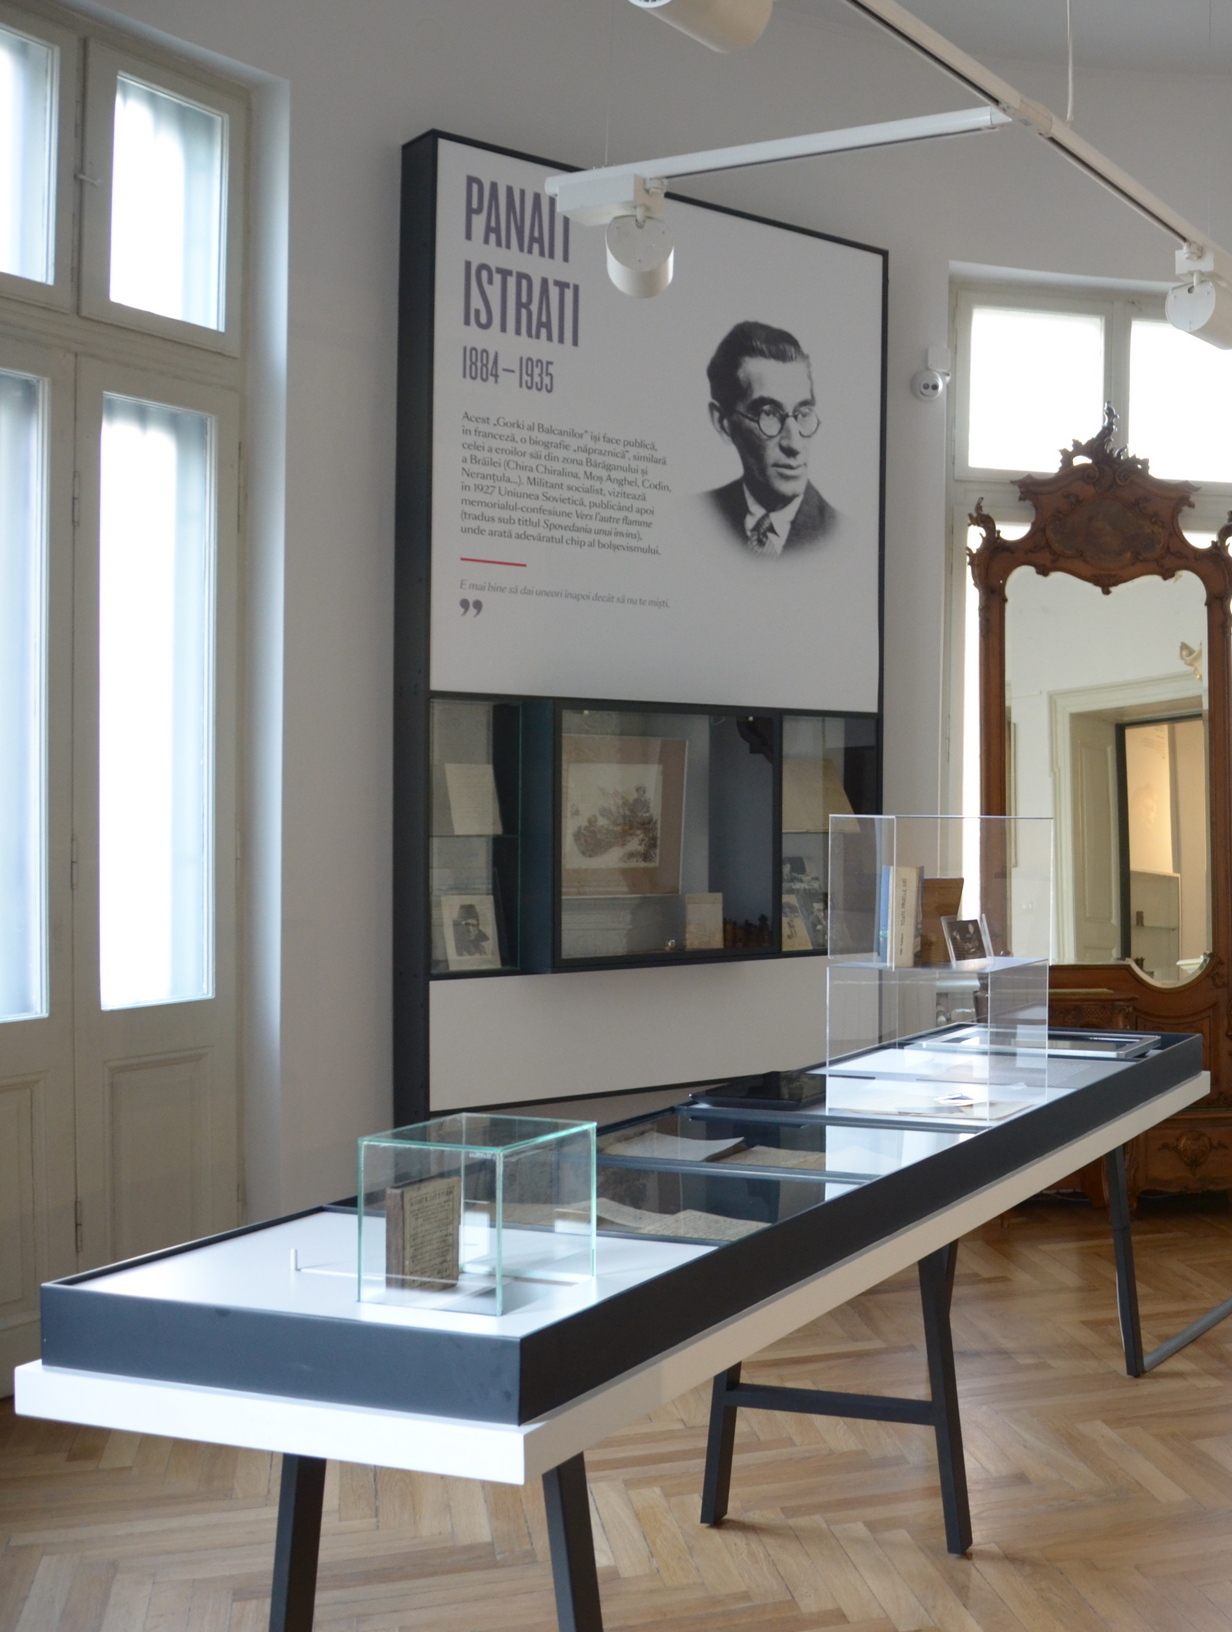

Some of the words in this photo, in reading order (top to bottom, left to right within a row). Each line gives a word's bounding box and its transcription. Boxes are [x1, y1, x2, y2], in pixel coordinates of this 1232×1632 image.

[463, 260, 580, 347] ISTRATI
[462, 411, 490, 425] Acest
[527, 421, 535, 432] al
[590, 431, 600, 444] își
[602, 433, 621, 445] face
[623, 437, 657, 452] publică,
[462, 425, 472, 436] în
[474, 426, 518, 443] franceză,
[529, 435, 571, 453] biografie
[633, 451, 666, 465] similară
[462, 439, 485, 452] celei
[495, 444, 527, 458] eroilor
[529, 449, 542, 460] săi
[544, 451, 559, 463] din
[562, 456, 583, 466] zona
[586, 457, 639, 476] Bărăganului
[641, 465, 648, 477] și
[470, 454, 501, 468] Brăilei
[504, 459, 534, 474] (Chira
[535, 463, 581, 480] Chiralina,
[584, 470, 603, 484] Moș
[605, 473, 640, 489] Anghel,
[461, 481, 471, 492] în
[474, 483, 496, 496] 1927
[498, 486, 539, 501] Uniunea
[542, 491, 587, 507] Sovietică,
[589, 498, 633, 514] publicând
[635, 504, 654, 517] apoi
[527, 476, 564, 490] Militant
[566, 481, 606, 496] socialist,
[608, 487, 646, 501] vizitează
[461, 495, 573, 518] memorialul-confesiune
[575, 509, 593, 521] Vers
[622, 515, 652, 528] flamme
[461, 509, 495, 525] (tradus
[497, 514, 516, 525] sub
[518, 516, 540, 528] titlul
[542, 518, 592, 536] Spovedania
[594, 525, 612, 537] unui
[614, 528, 642, 542] învins),
[461, 523, 486, 536] unde
[488, 527, 512, 538] arată
[514, 529, 563, 544] adevăratul
[565, 535, 586, 549] chip
[587, 538, 595, 548] al
[598, 539, 660, 557] bolșevismului.
[469, 580, 487, 591] mai
[487, 582, 508, 593] bine
[508, 584, 519, 594] să
[520, 585, 534, 596] dai
[535, 587, 563, 598] uneori
[564, 589, 591, 603] înapoi
[592, 592, 615, 603] decât
[616, 595, 626, 604] să
